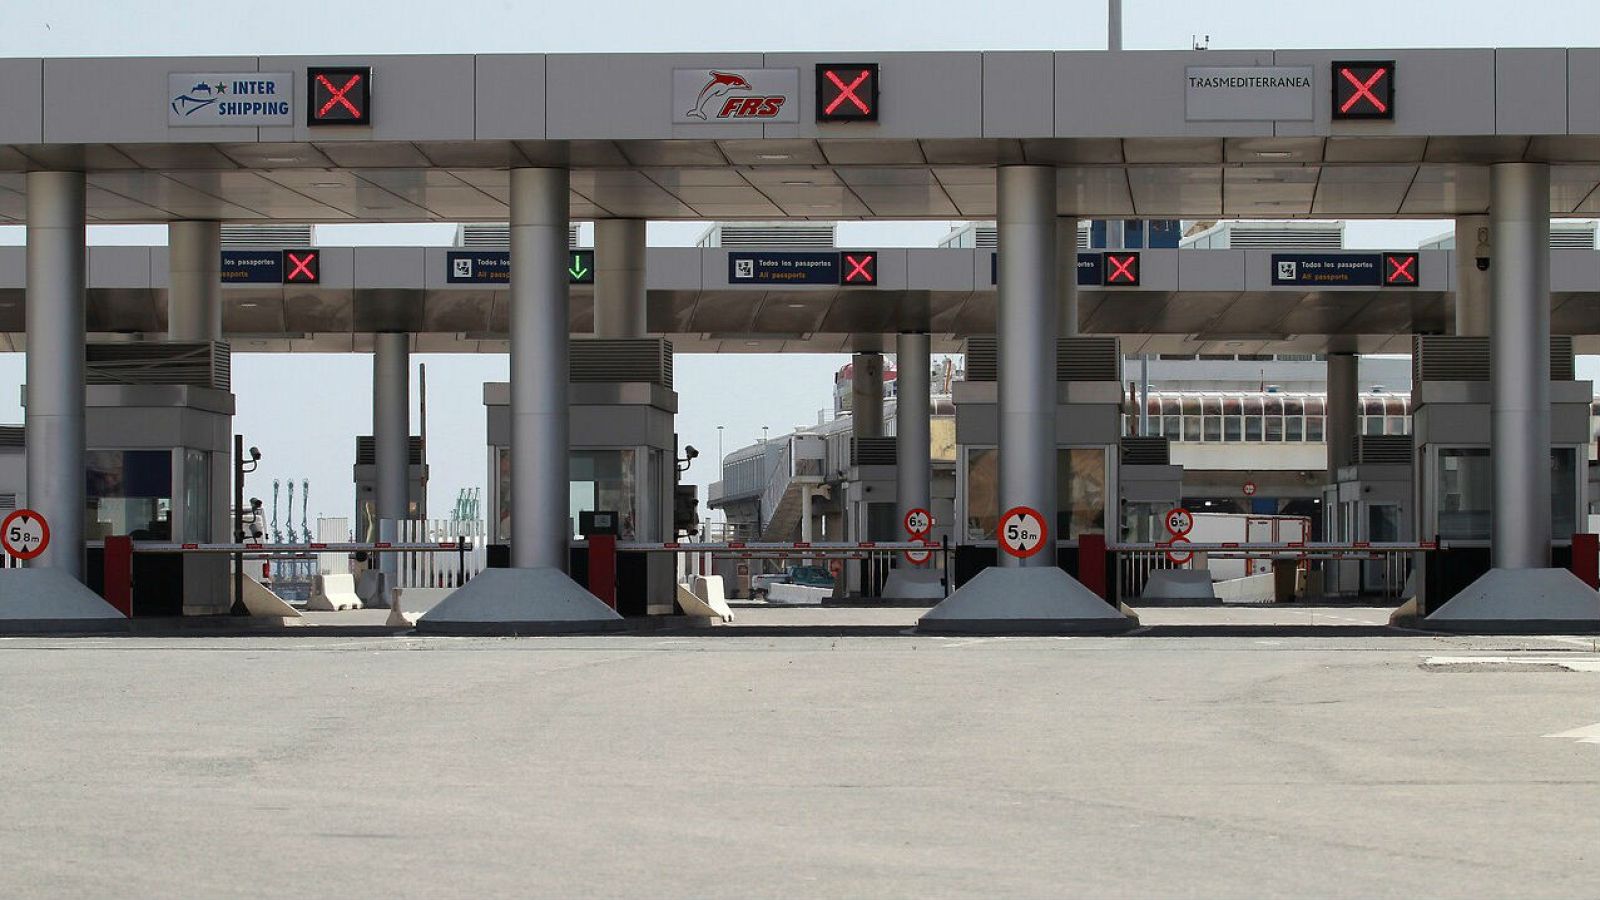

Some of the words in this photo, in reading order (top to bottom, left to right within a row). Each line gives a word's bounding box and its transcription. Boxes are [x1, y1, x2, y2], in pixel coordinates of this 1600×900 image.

[233, 81, 275, 94] INTER
[1188, 77, 1310, 88] TRASMEDITERRANEA
[218, 102, 289, 115] SHIPPING
[717, 95, 786, 118] FRS
